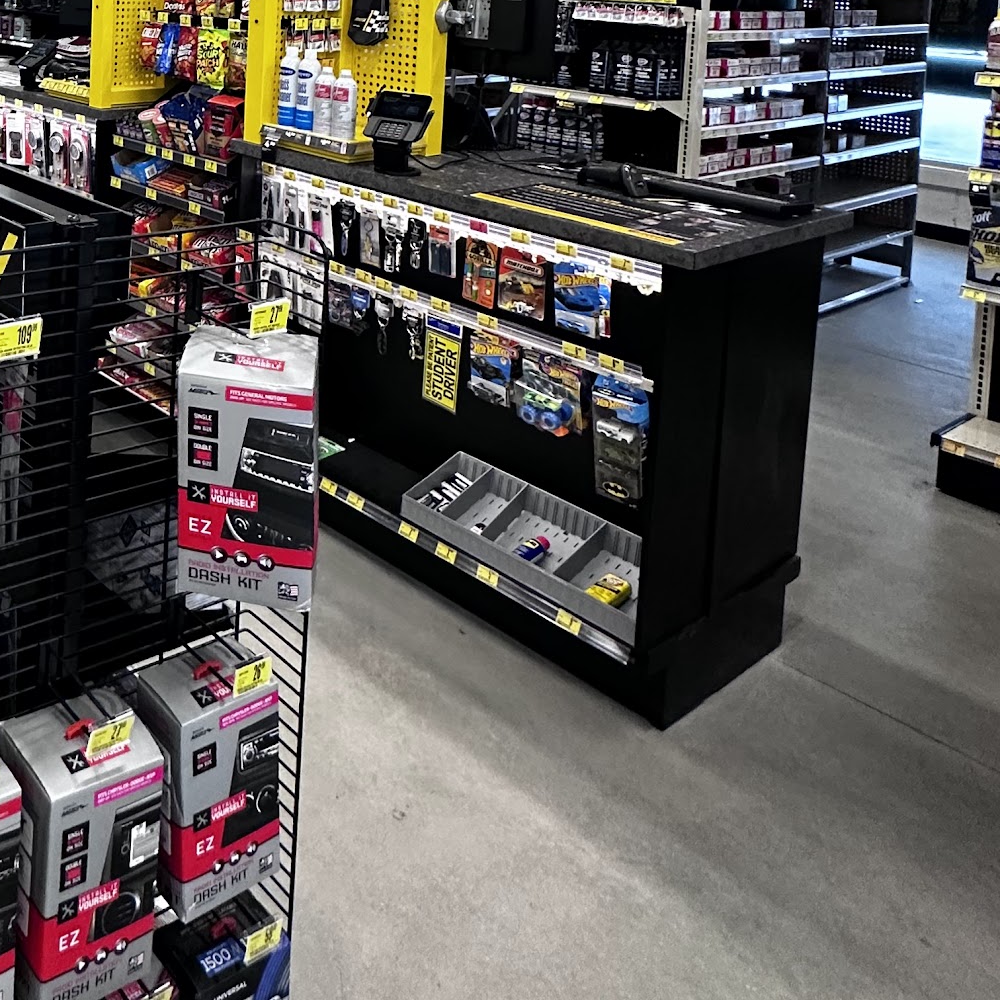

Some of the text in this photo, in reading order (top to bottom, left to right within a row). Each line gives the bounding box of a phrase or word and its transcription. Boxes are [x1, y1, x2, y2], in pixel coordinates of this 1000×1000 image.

[164, 2, 185, 11] Doritos
[197, 59, 219, 67] PATCH
[198, 49, 218, 59] SOUR
[467, 251, 494, 267] GORILLA
[506, 259, 540, 274] MATCHBOX
[557, 274, 573, 286] HOT
[427, 361, 433, 371] BE
[432, 337, 446, 400] STUDENT
[443, 349, 457, 400] DRIVER
[241, 391, 264, 399] GENERAL
[265, 394, 288, 402] MOTORS
[194, 413, 212, 421] SINGLE
[210, 493, 257, 509] YOURSELF
[211, 488, 246, 499] INSTALL
[188, 517, 212, 535] EZ
[188, 558, 269, 579] RADIO INSTALLATION
[188, 567, 262, 591] DASH KIT
[212, 797, 235, 812] INSTALL
[212, 799, 245, 820] YOURSELF
[196, 835, 215, 857] EZ
[79, 881, 118, 904] INSTALL IT
[194, 868, 248, 903] DASH KIT
[78, 888, 118, 912] YOURSELF
[59, 929, 80, 952] EZ
[200, 948, 231, 973] 1500
[52, 967, 116, 1000] DASH KIT
